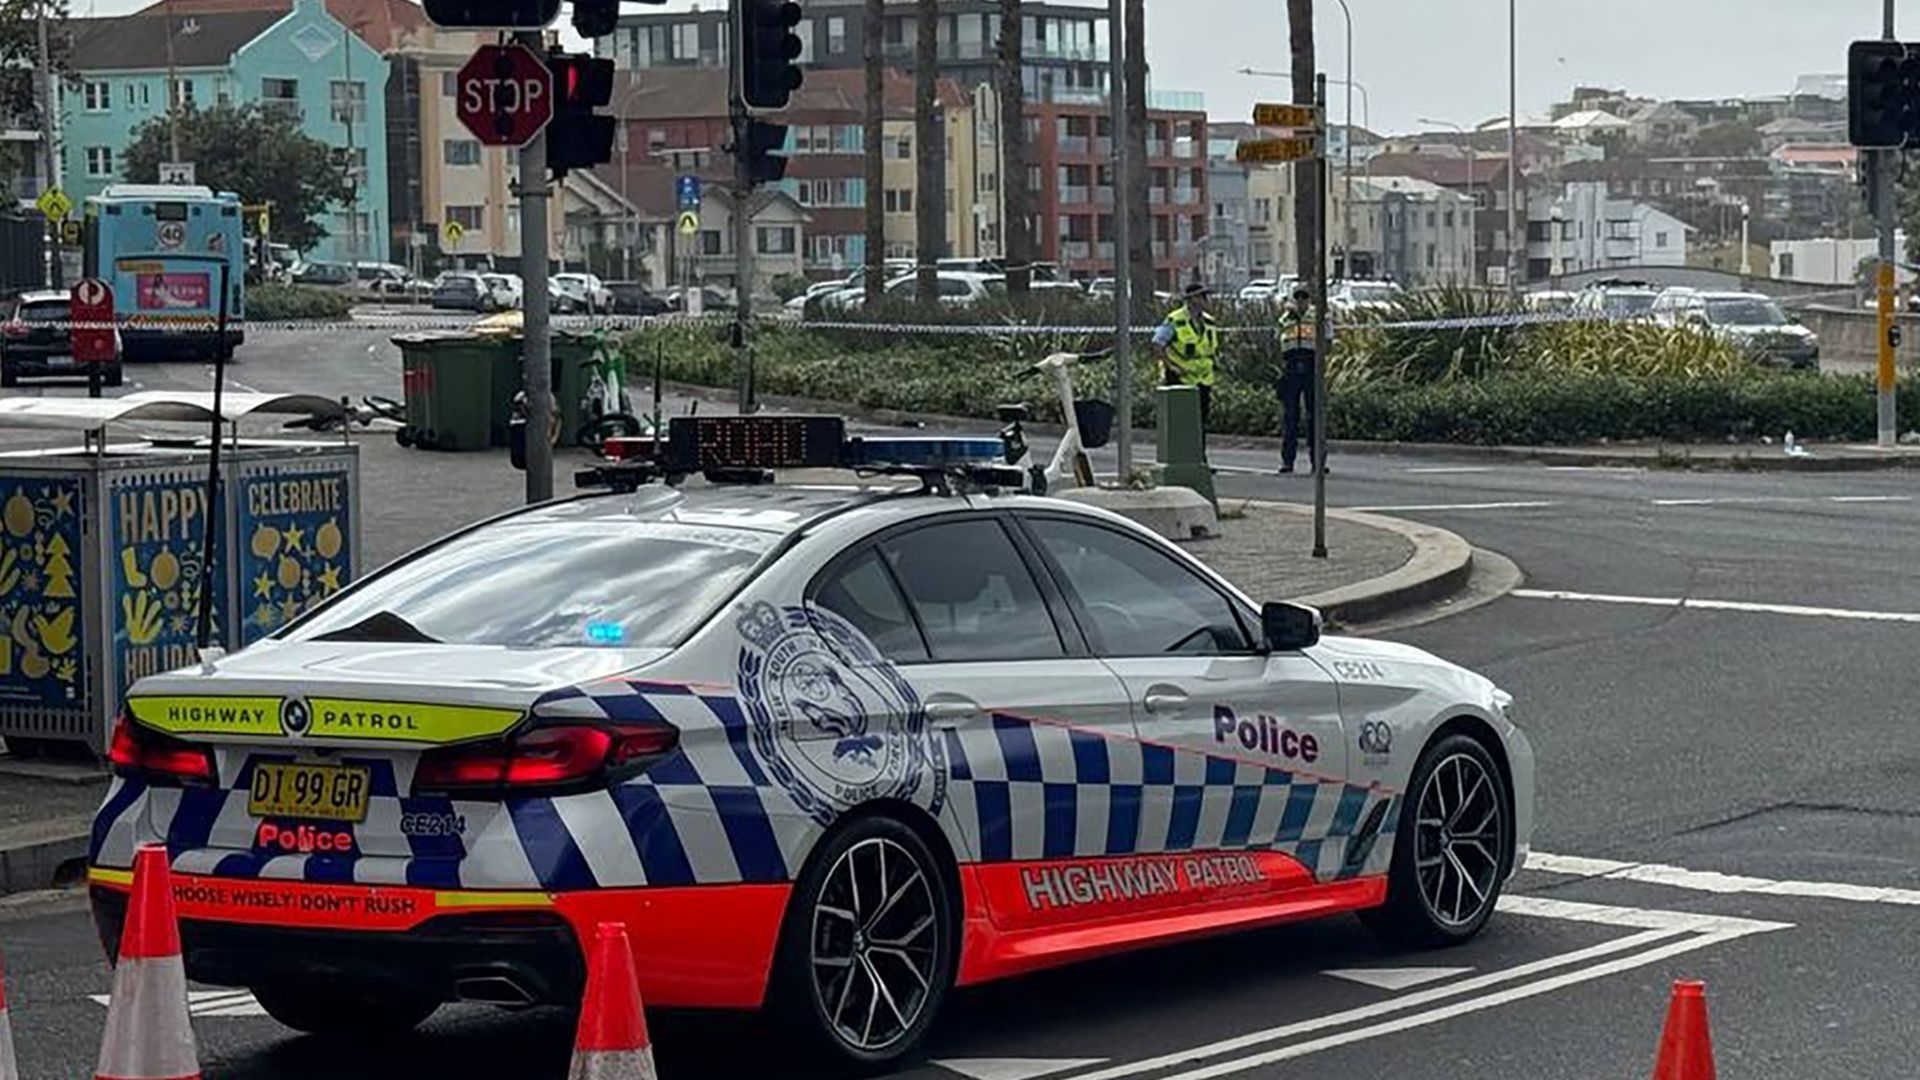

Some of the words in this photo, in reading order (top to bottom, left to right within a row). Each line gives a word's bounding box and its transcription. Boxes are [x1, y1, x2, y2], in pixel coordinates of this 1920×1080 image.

[464, 78, 544, 114] STOP
[698, 419, 807, 465] ROAD
[248, 479, 341, 516] CELEBRATE
[125, 643, 199, 687] HOLIDA
[168, 706, 264, 724] HIGHWAY
[324, 711, 419, 730] PATROL
[1214, 703, 1319, 763] Police
[254, 768, 283, 803] DI
[295, 771, 324, 806] 99
[332, 773, 362, 808] GR
[258, 823, 352, 851] Police
[400, 814, 467, 836] CE214
[172, 884, 227, 902] HOOSE
[365, 897, 417, 914] RUSH
[1022, 860, 1180, 909] HIGHWAY
[1184, 855, 1266, 889] PATROL
